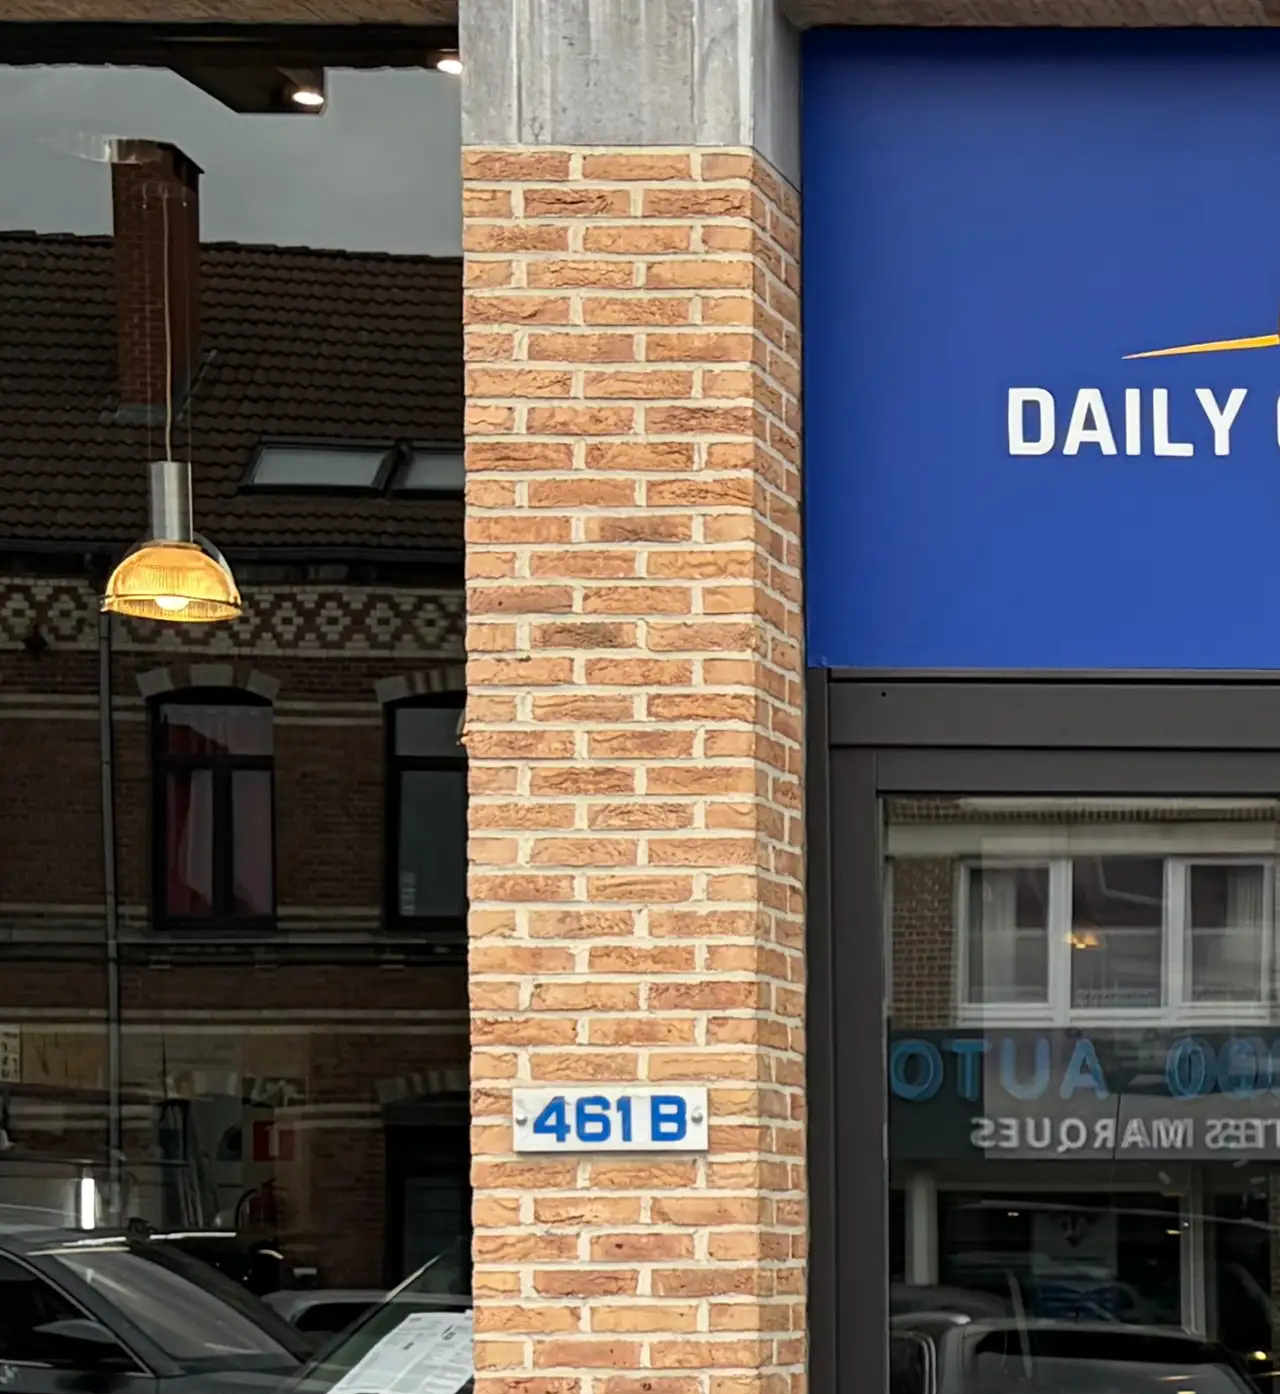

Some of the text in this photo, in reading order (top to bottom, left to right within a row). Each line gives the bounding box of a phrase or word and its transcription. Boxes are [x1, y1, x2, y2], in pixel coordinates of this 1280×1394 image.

[1008, 387, 1248, 457] DAILY
[534, 1095, 687, 1142] 461 B
